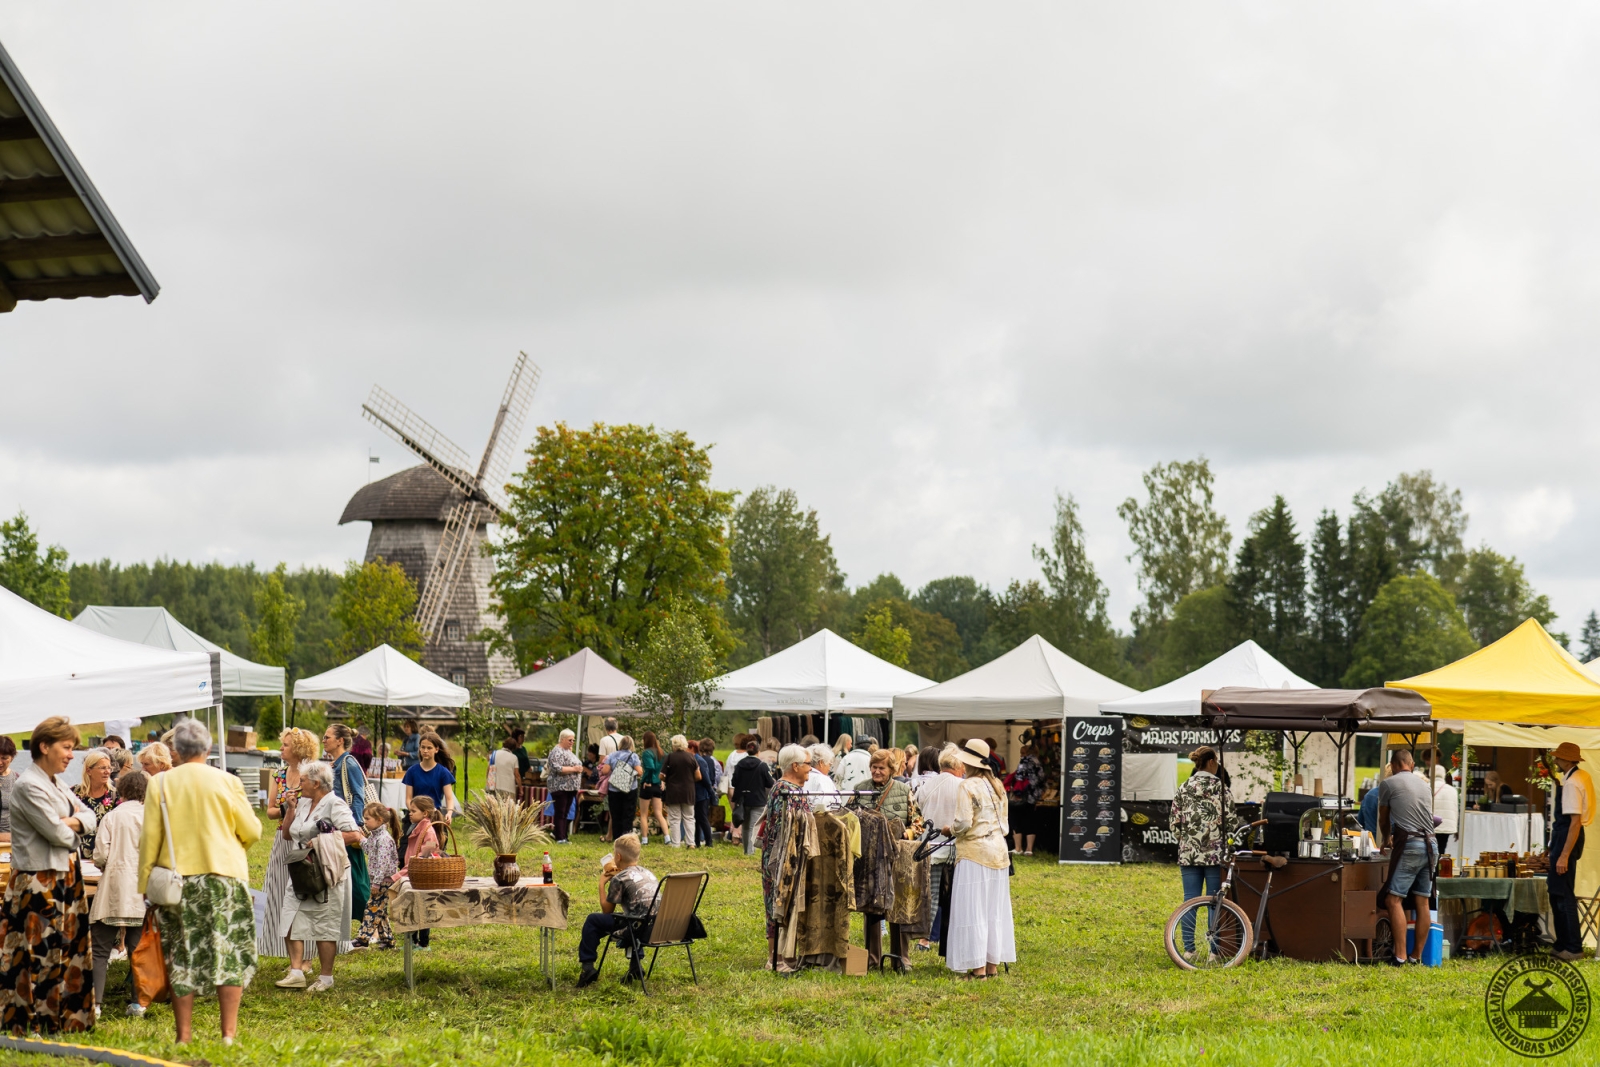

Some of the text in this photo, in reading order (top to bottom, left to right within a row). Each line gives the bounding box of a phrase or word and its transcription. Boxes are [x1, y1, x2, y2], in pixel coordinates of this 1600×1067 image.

[1072, 720, 1115, 741] Creps
[1140, 727, 1180, 745] MĀJAS
[1142, 826, 1179, 845] MĀJAS
